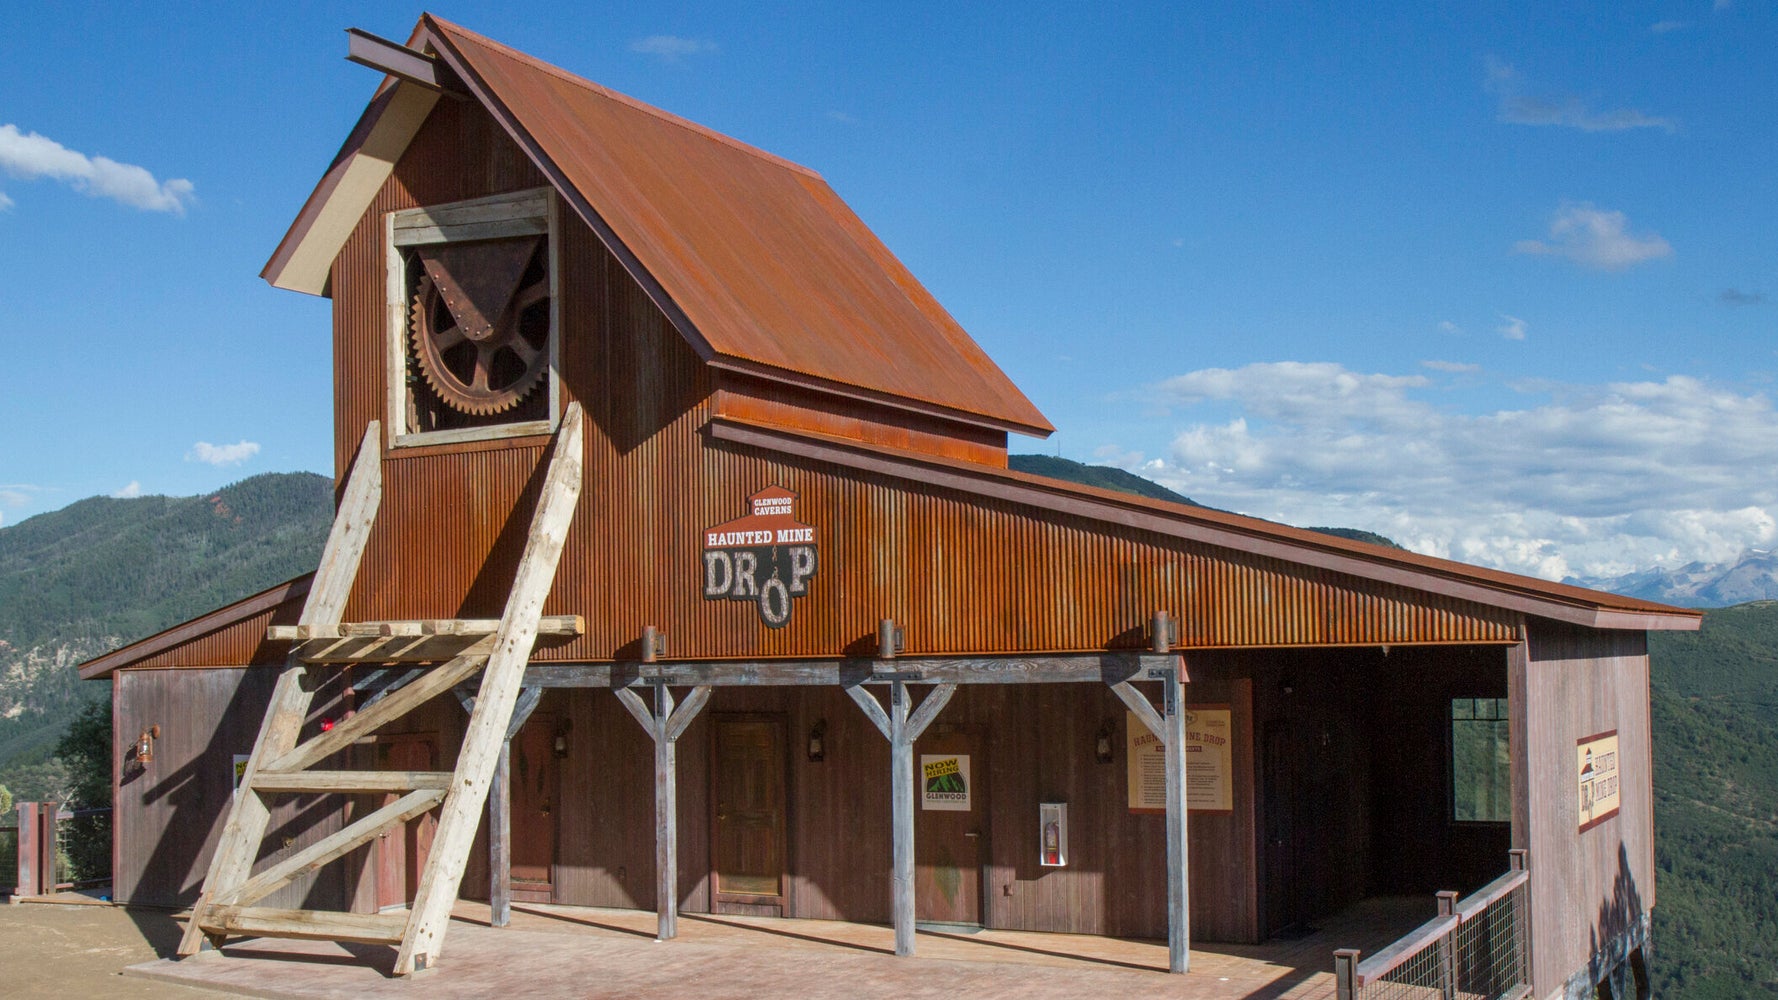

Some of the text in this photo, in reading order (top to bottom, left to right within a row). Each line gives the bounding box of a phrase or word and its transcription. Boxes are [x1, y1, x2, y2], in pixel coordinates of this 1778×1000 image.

[754, 498, 792, 506] GLENWOOD
[754, 506, 792, 516] CAVERNS
[708, 528, 813, 546] HAUNTED MINE
[705, 546, 815, 623] DROP
[1134, 734, 1158, 746] HAUN
[1204, 734, 1226, 746] DROP
[925, 759, 957, 770] NOW
[926, 766, 959, 776] HIRING
